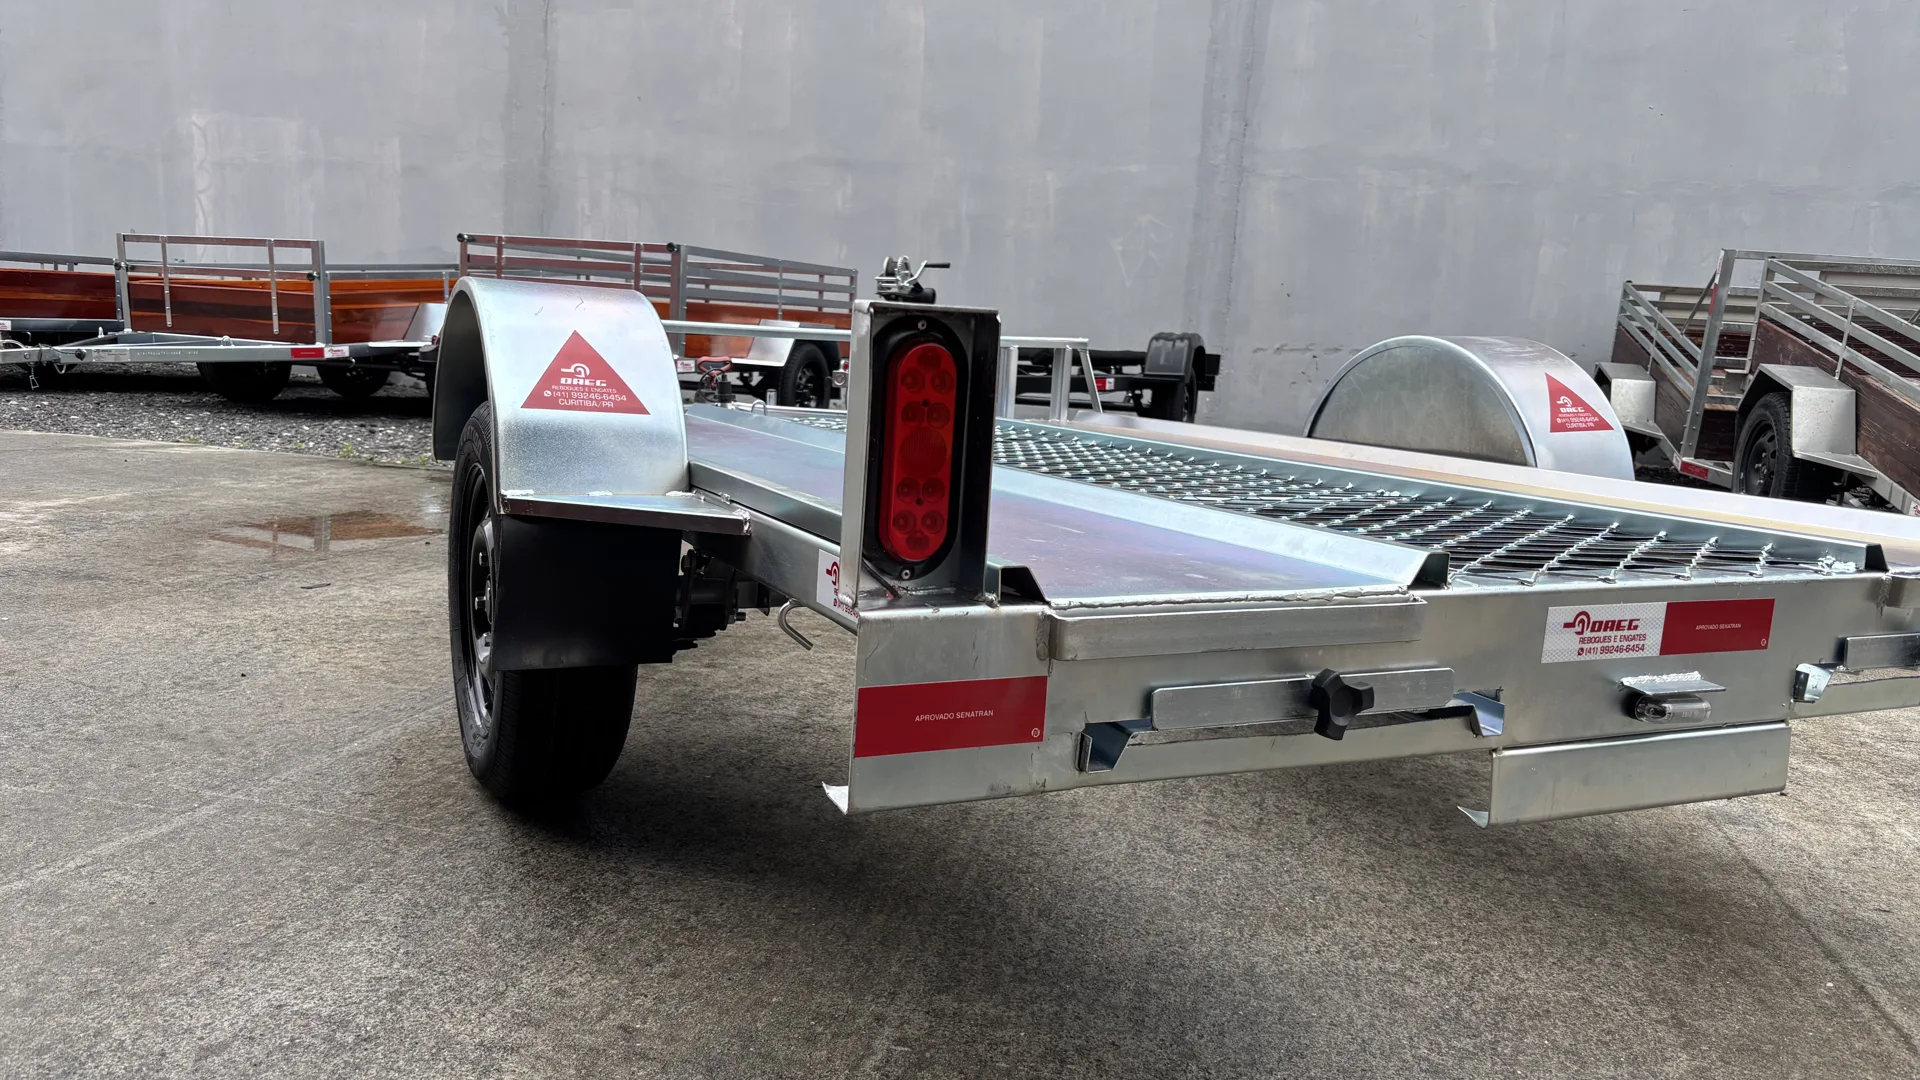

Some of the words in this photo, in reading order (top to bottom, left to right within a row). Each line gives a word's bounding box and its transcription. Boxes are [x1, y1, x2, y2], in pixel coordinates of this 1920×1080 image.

[560, 378, 607, 386] DAEG
[571, 392, 627, 401] 99246-6454
[559, 398, 614, 407] CURITIBA/PR
[1590, 619, 1640, 632] DAEG
[1578, 635, 1612, 645] REBOQUES
[1619, 633, 1647, 643] ENGATES
[1585, 647, 1598, 655] (41)
[1600, 644, 1645, 654] 99246-6454
[915, 712, 955, 722] APROVADO
[955, 709, 994, 719] SENATRAN
